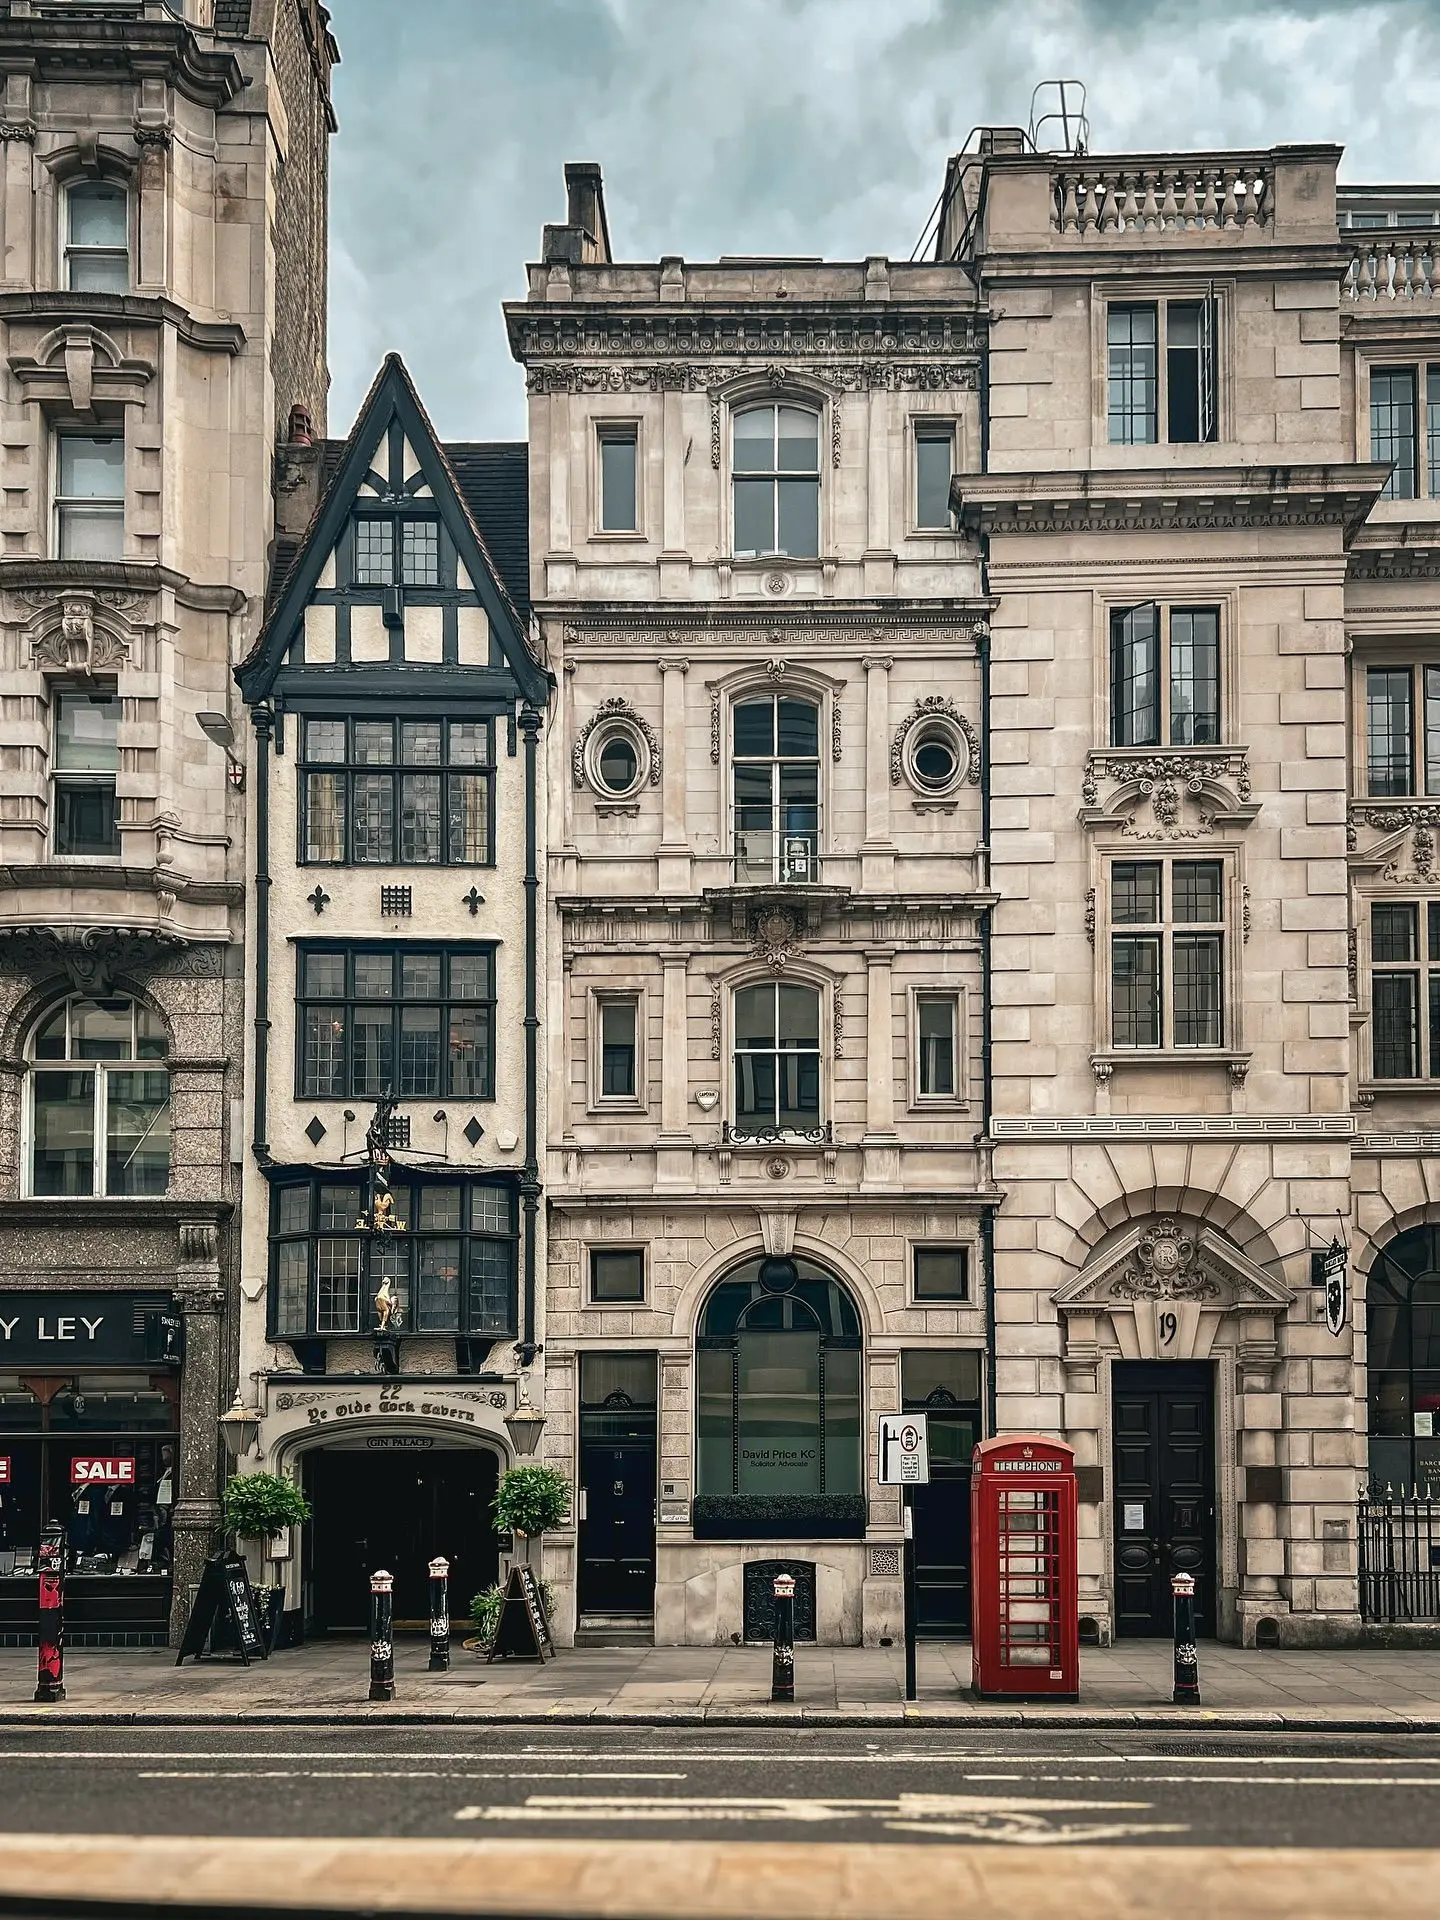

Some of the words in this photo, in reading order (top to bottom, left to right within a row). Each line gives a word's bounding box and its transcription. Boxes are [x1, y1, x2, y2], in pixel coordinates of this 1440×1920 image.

[38, 1317, 104, 1340] LEY
[1159, 1312, 1177, 1346] 19
[380, 1384, 402, 1400] 22
[308, 1407, 327, 1425] Ye
[336, 1401, 372, 1417] Olde
[379, 1401, 415, 1413] Cock
[421, 1403, 475, 1422] Tavern
[370, 1438, 389, 1447] GIN
[392, 1438, 429, 1447] PALACE
[614, 1451, 622, 1459] 21
[742, 1450, 769, 1459] David
[772, 1450, 797, 1459] Price
[800, 1450, 816, 1459] KC
[75, 1462, 132, 1479] SALE
[997, 1462, 1061, 1471] TELEPHONE
